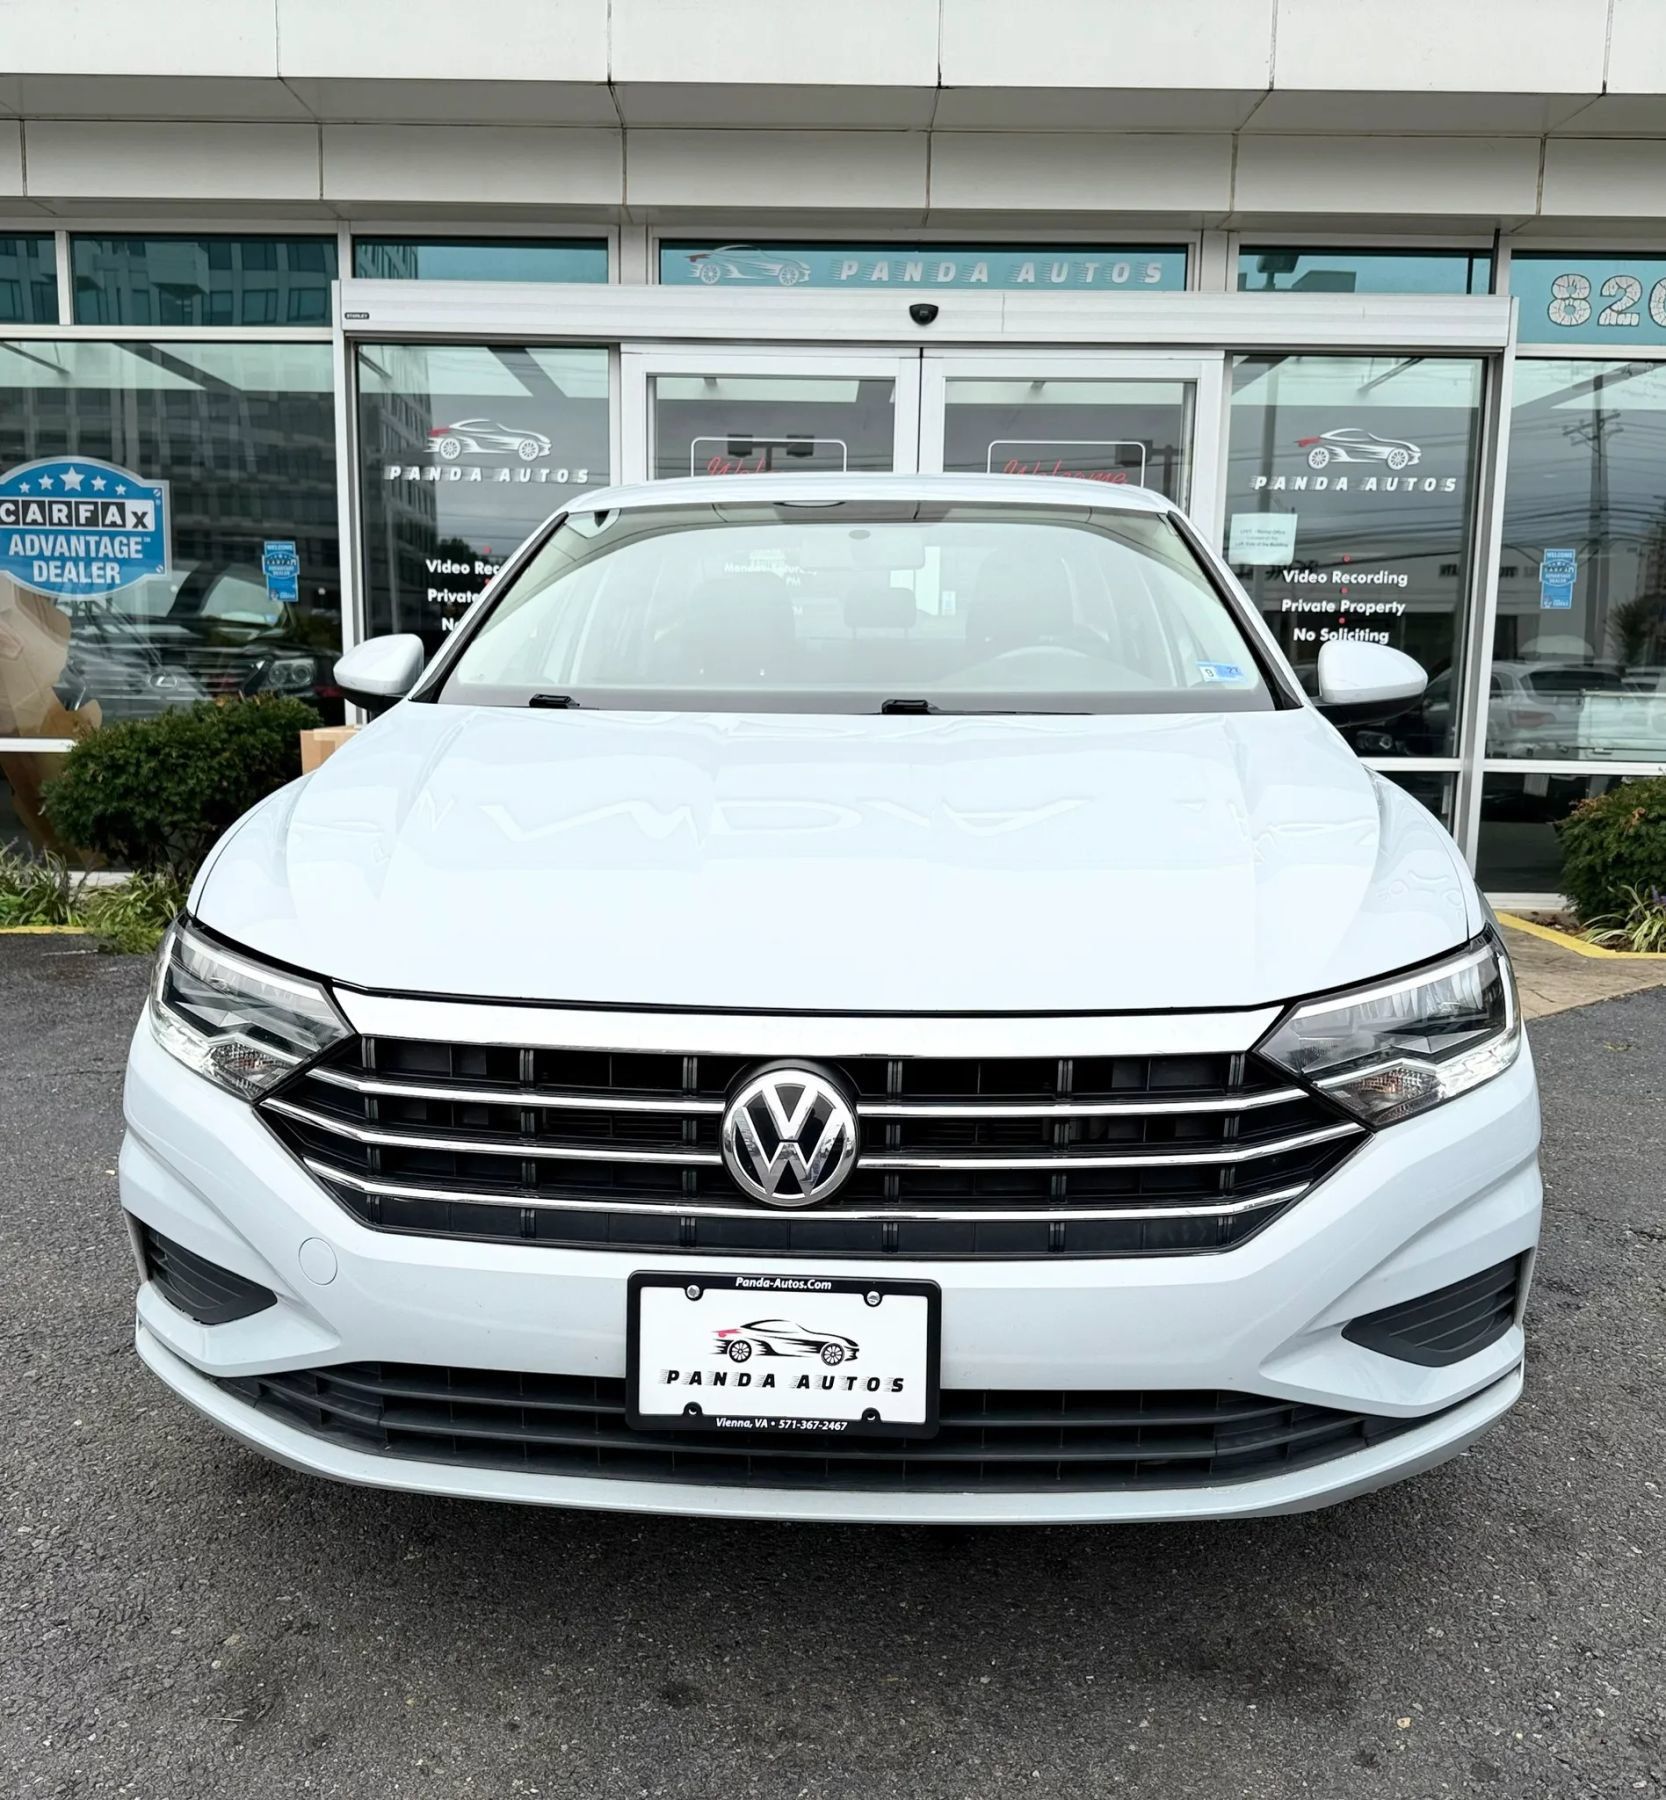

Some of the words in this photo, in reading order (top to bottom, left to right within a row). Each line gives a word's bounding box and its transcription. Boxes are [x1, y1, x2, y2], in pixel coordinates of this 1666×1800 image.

[839, 261, 989, 284] PANDA
[1016, 262, 1163, 285] AUTOS
[388, 466, 483, 482] PANDA
[499, 468, 590, 484] AUTOS
[1254, 476, 1349, 490] PANDA
[1364, 477, 1457, 492] AUTOS
[0, 502, 149, 529] CARFAX
[9, 533, 144, 559] ADVANTAGE
[32, 560, 121, 584] DEALER
[425, 559, 470, 575] Video
[1282, 569, 1328, 585] Video
[1332, 570, 1409, 588] Recording
[1281, 599, 1336, 613] Private
[1340, 600, 1406, 616] Property
[1293, 628, 1316, 642] No
[1319, 628, 1390, 645] Soliciting
[735, 1277, 833, 1291] Panda-Autos.Com
[665, 1369, 776, 1388] PANDA
[796, 1374, 905, 1393] AUTOS
[715, 1417, 753, 1430] Vienna,
[754, 1419, 769, 1429] VA
[778, 1420, 848, 1432] 571-367-2467
